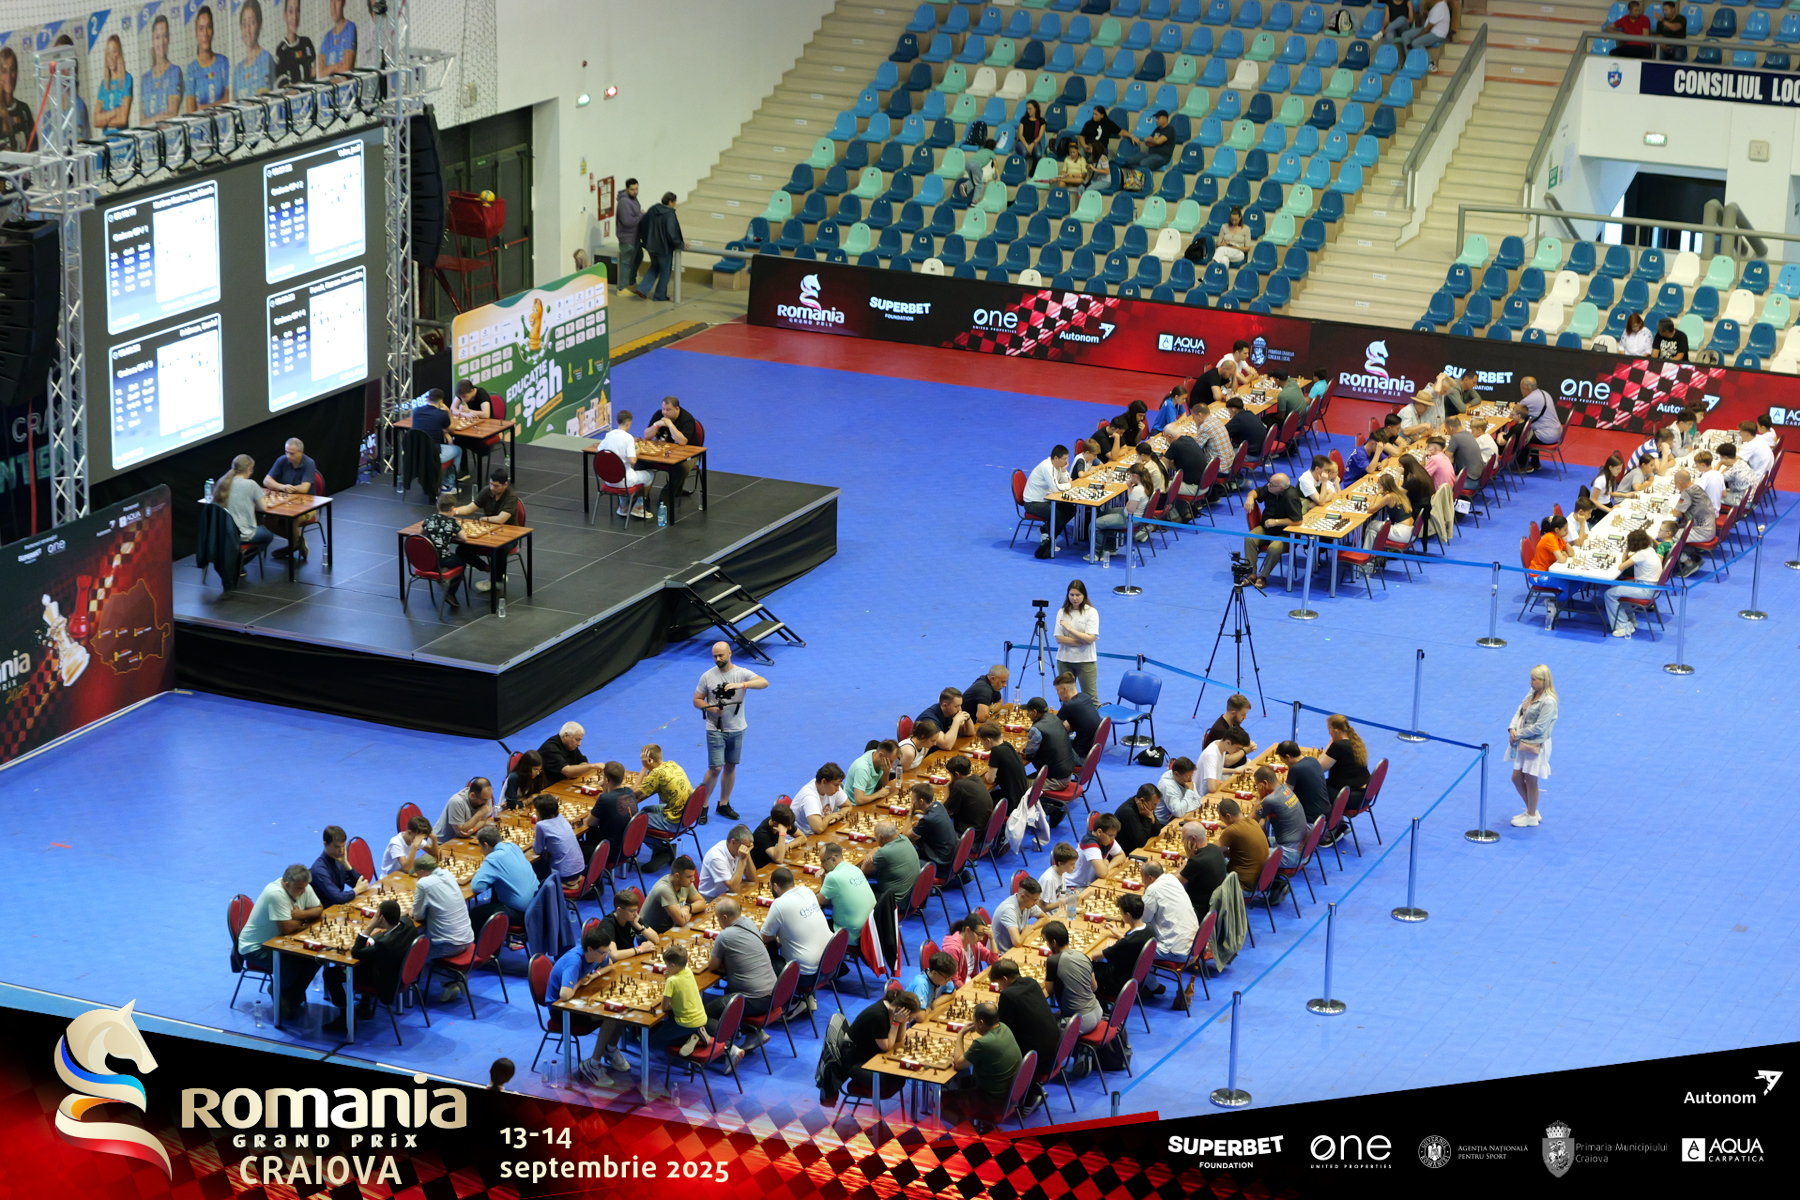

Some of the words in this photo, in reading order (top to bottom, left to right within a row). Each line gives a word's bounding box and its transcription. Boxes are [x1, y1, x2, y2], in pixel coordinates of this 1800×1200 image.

[91, 16, 98, 35] 2
[1674, 69, 1763, 100] CONSILIUL
[869, 296, 931, 315] SUPERBET
[885, 313, 914, 322] FOUNDATION
[973, 308, 1018, 329] one
[1059, 331, 1099, 343] Autonom
[1174, 337, 1205, 350] AQUA
[1173, 346, 1205, 355] CARPATICA
[1560, 378, 1611, 400] one
[0, 650, 31, 684] nia
